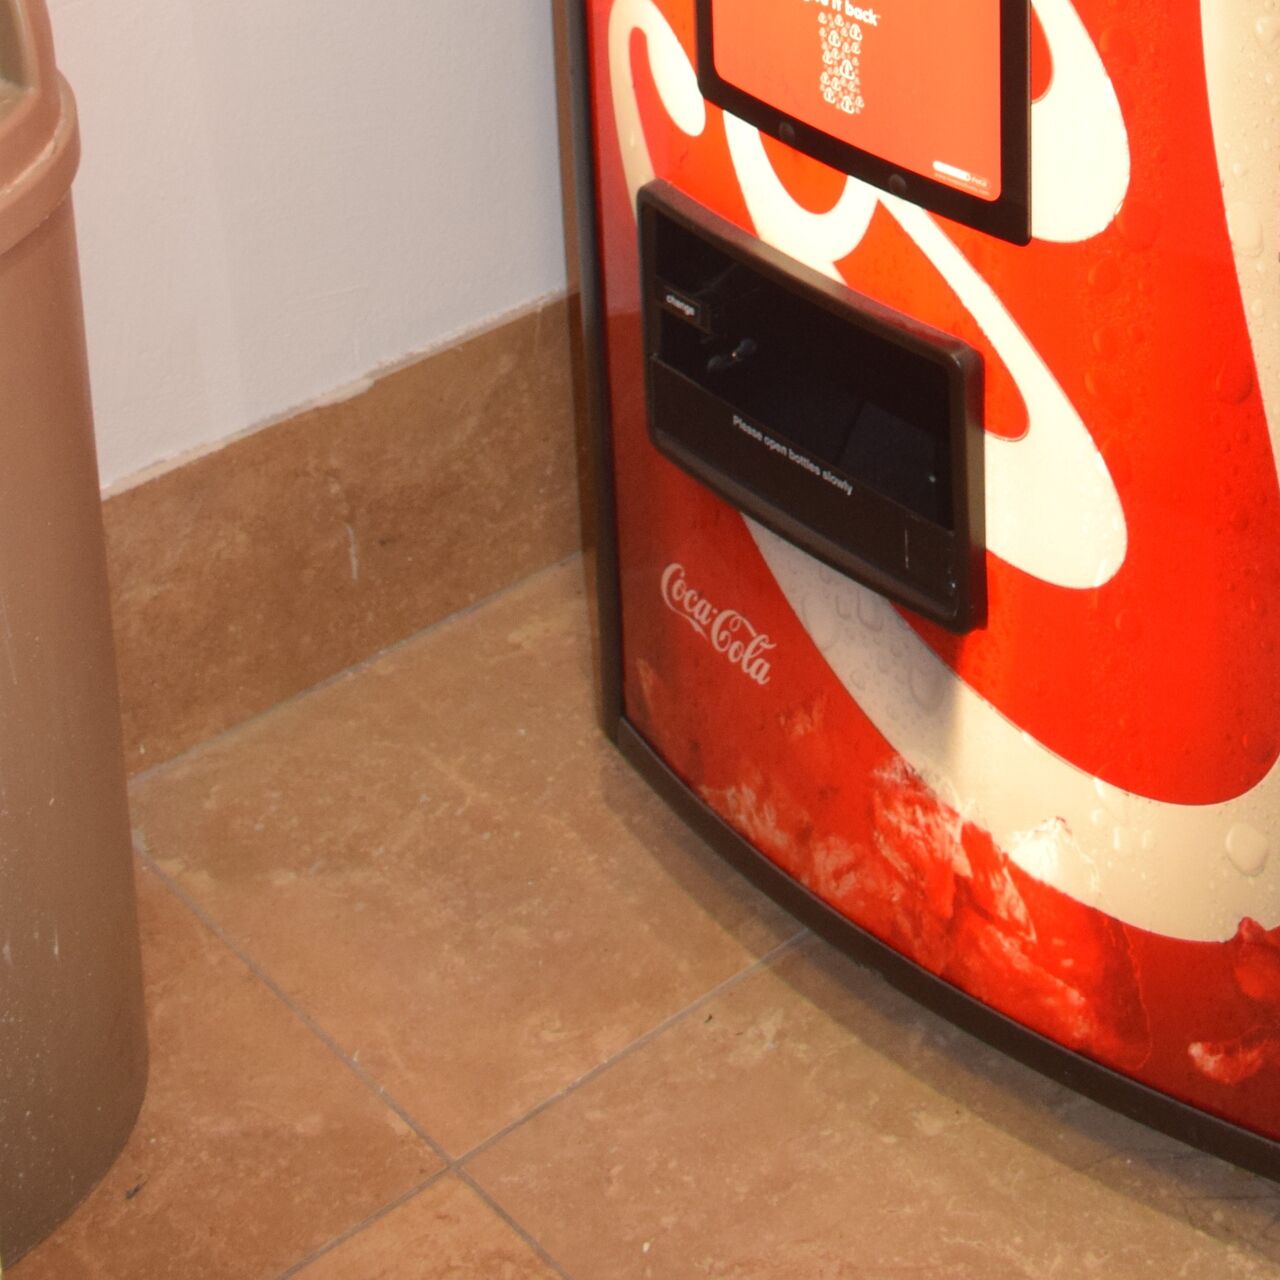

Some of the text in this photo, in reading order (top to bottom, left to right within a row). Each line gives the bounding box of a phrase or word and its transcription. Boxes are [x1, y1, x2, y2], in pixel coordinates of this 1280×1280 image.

[844, 0, 878, 27] back
[666, 294, 695, 316] change
[733, 414, 853, 496] Please open bottles slowly
[661, 562, 777, 686] Coca-Cola
